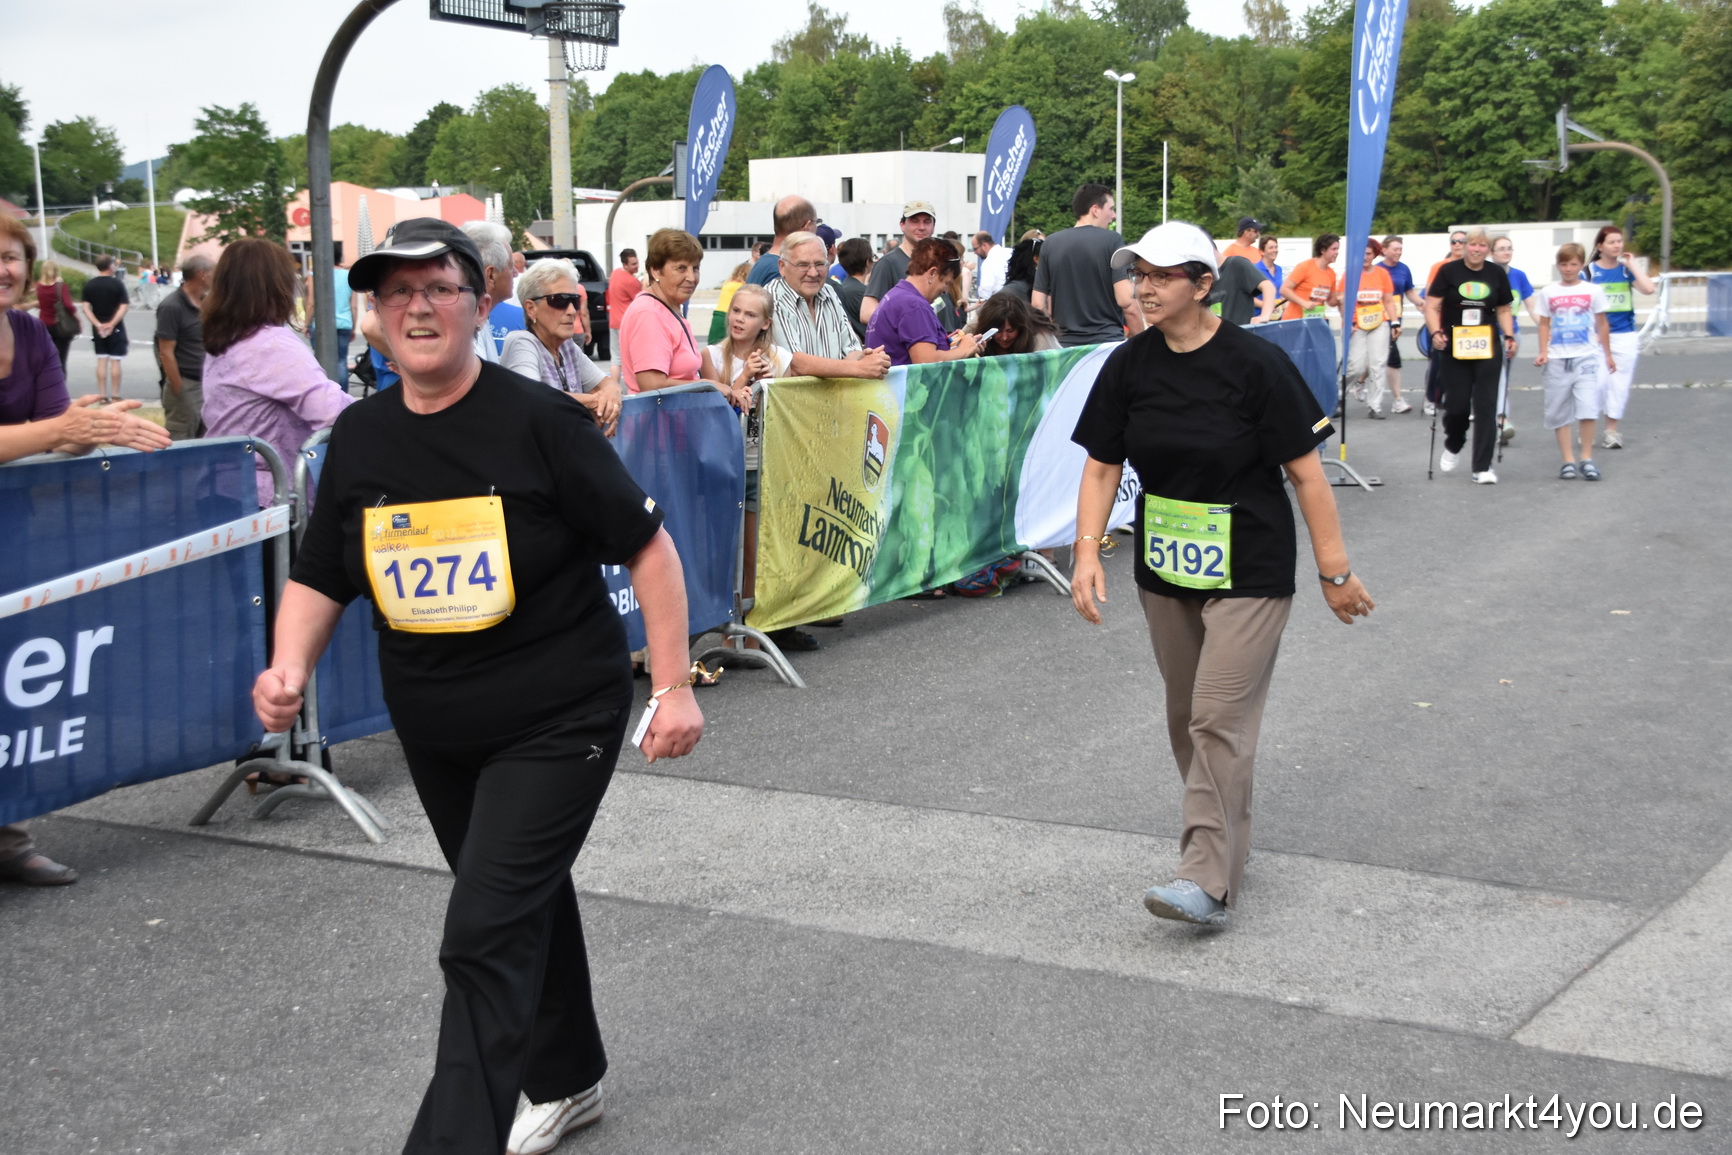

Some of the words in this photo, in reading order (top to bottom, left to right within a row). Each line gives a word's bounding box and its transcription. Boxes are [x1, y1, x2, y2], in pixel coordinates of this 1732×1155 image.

[696, 91, 727, 186] Fischer
[994, 123, 1026, 202] Fischer
[1363, 314, 1380, 323] 607
[1457, 339, 1487, 351] 1349
[826, 476, 885, 540] Neumark
[384, 525, 429, 538] firmenlauf
[384, 551, 498, 599] 1274
[1149, 536, 1225, 577] 5192
[411, 605, 448, 616] Elisabeth
[448, 604, 478, 614] Philipp
